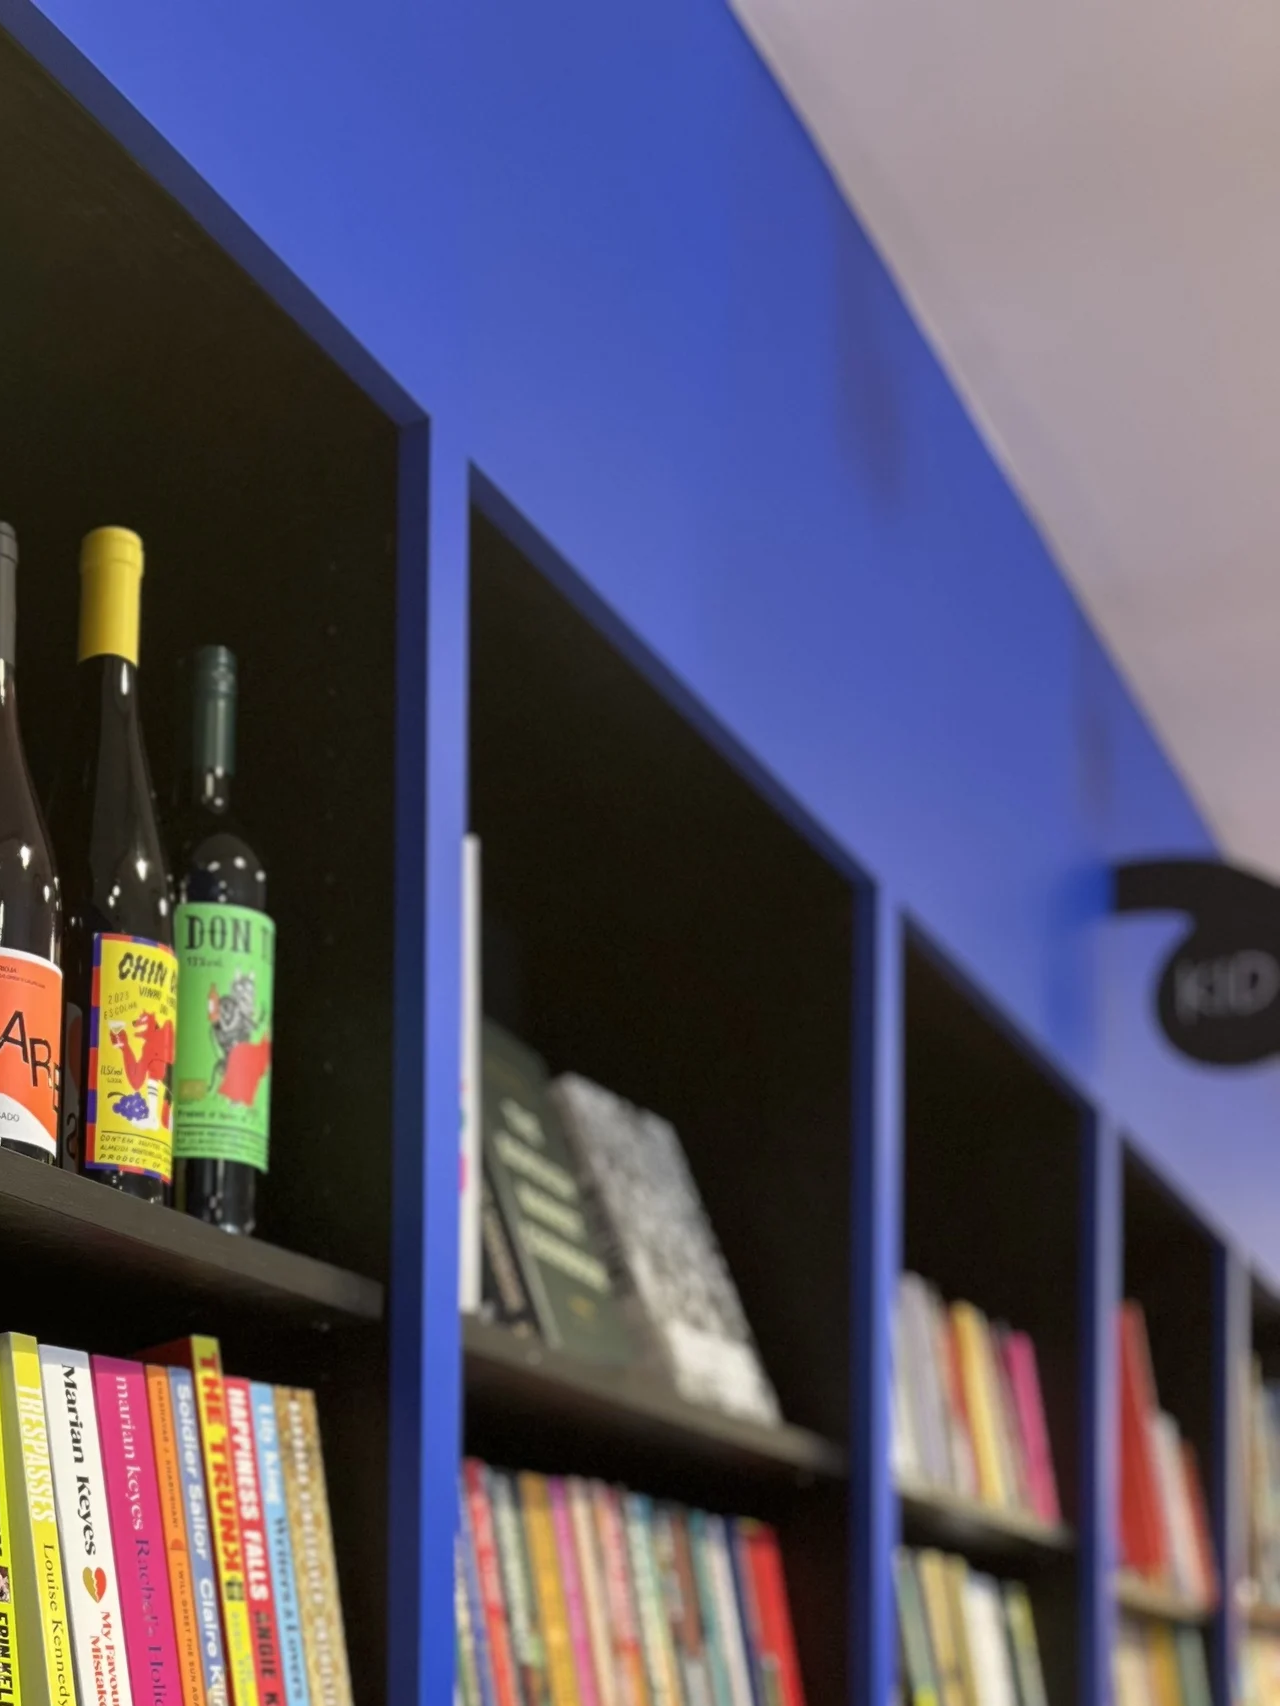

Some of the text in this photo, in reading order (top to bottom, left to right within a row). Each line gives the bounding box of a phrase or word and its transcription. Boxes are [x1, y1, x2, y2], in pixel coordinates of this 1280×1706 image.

[118, 952, 167, 986] CHIN
[185, 915, 251, 952] DON
[18, 1385, 55, 1523] TRESPASSES
[61, 1364, 96, 1556] Marian Keyes
[116, 1376, 144, 1531] marian keyes
[177, 1385, 208, 1559] Soldier Sailor
[228, 1388, 268, 1601] HAPPINESS FALLS
[43, 1544, 58, 1611] Louise
